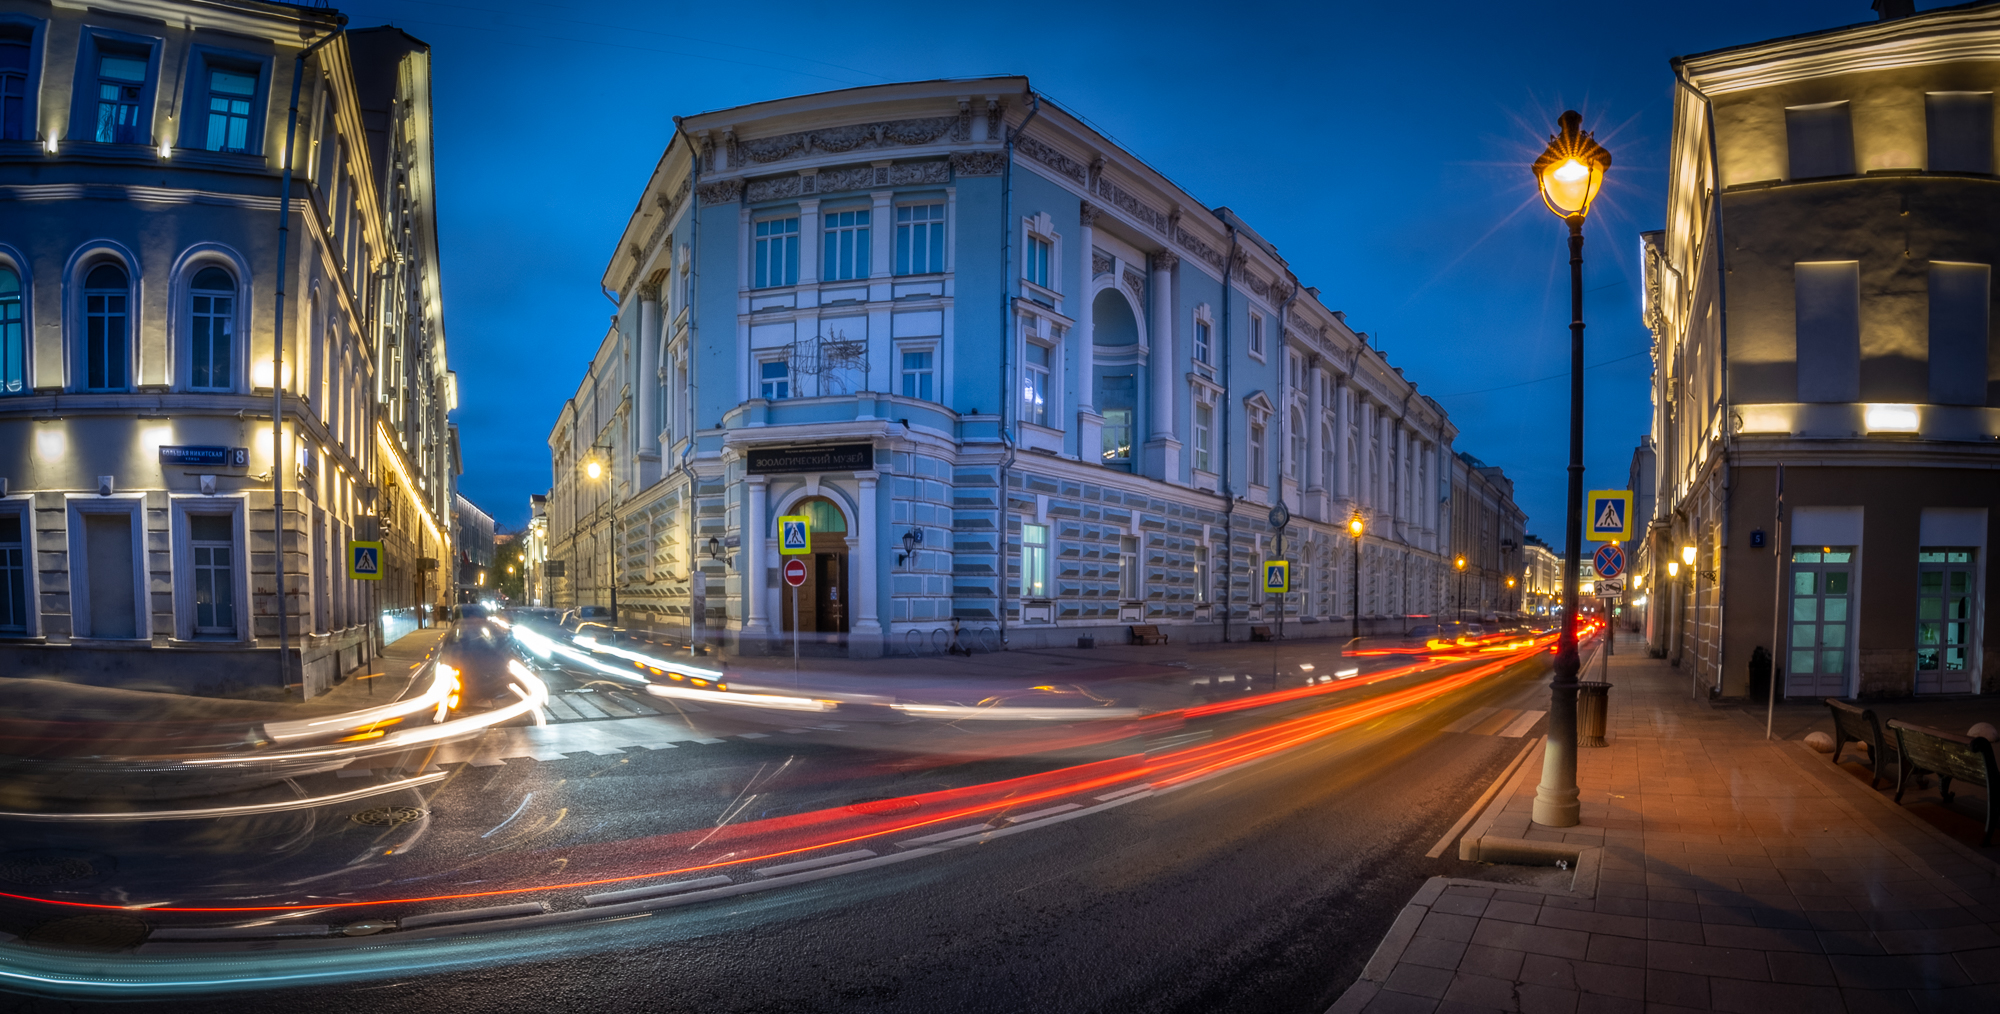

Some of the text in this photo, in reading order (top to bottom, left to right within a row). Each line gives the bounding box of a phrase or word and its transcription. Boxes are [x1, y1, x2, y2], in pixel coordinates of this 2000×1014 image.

[189, 450, 223, 458] НИКИТСКАЯ
[236, 449, 244, 464] 8
[755, 452, 864, 467] ЗООЛОГИЧЕСКИЙ МУЗЕЙ
[1755, 534, 1761, 543] 5
